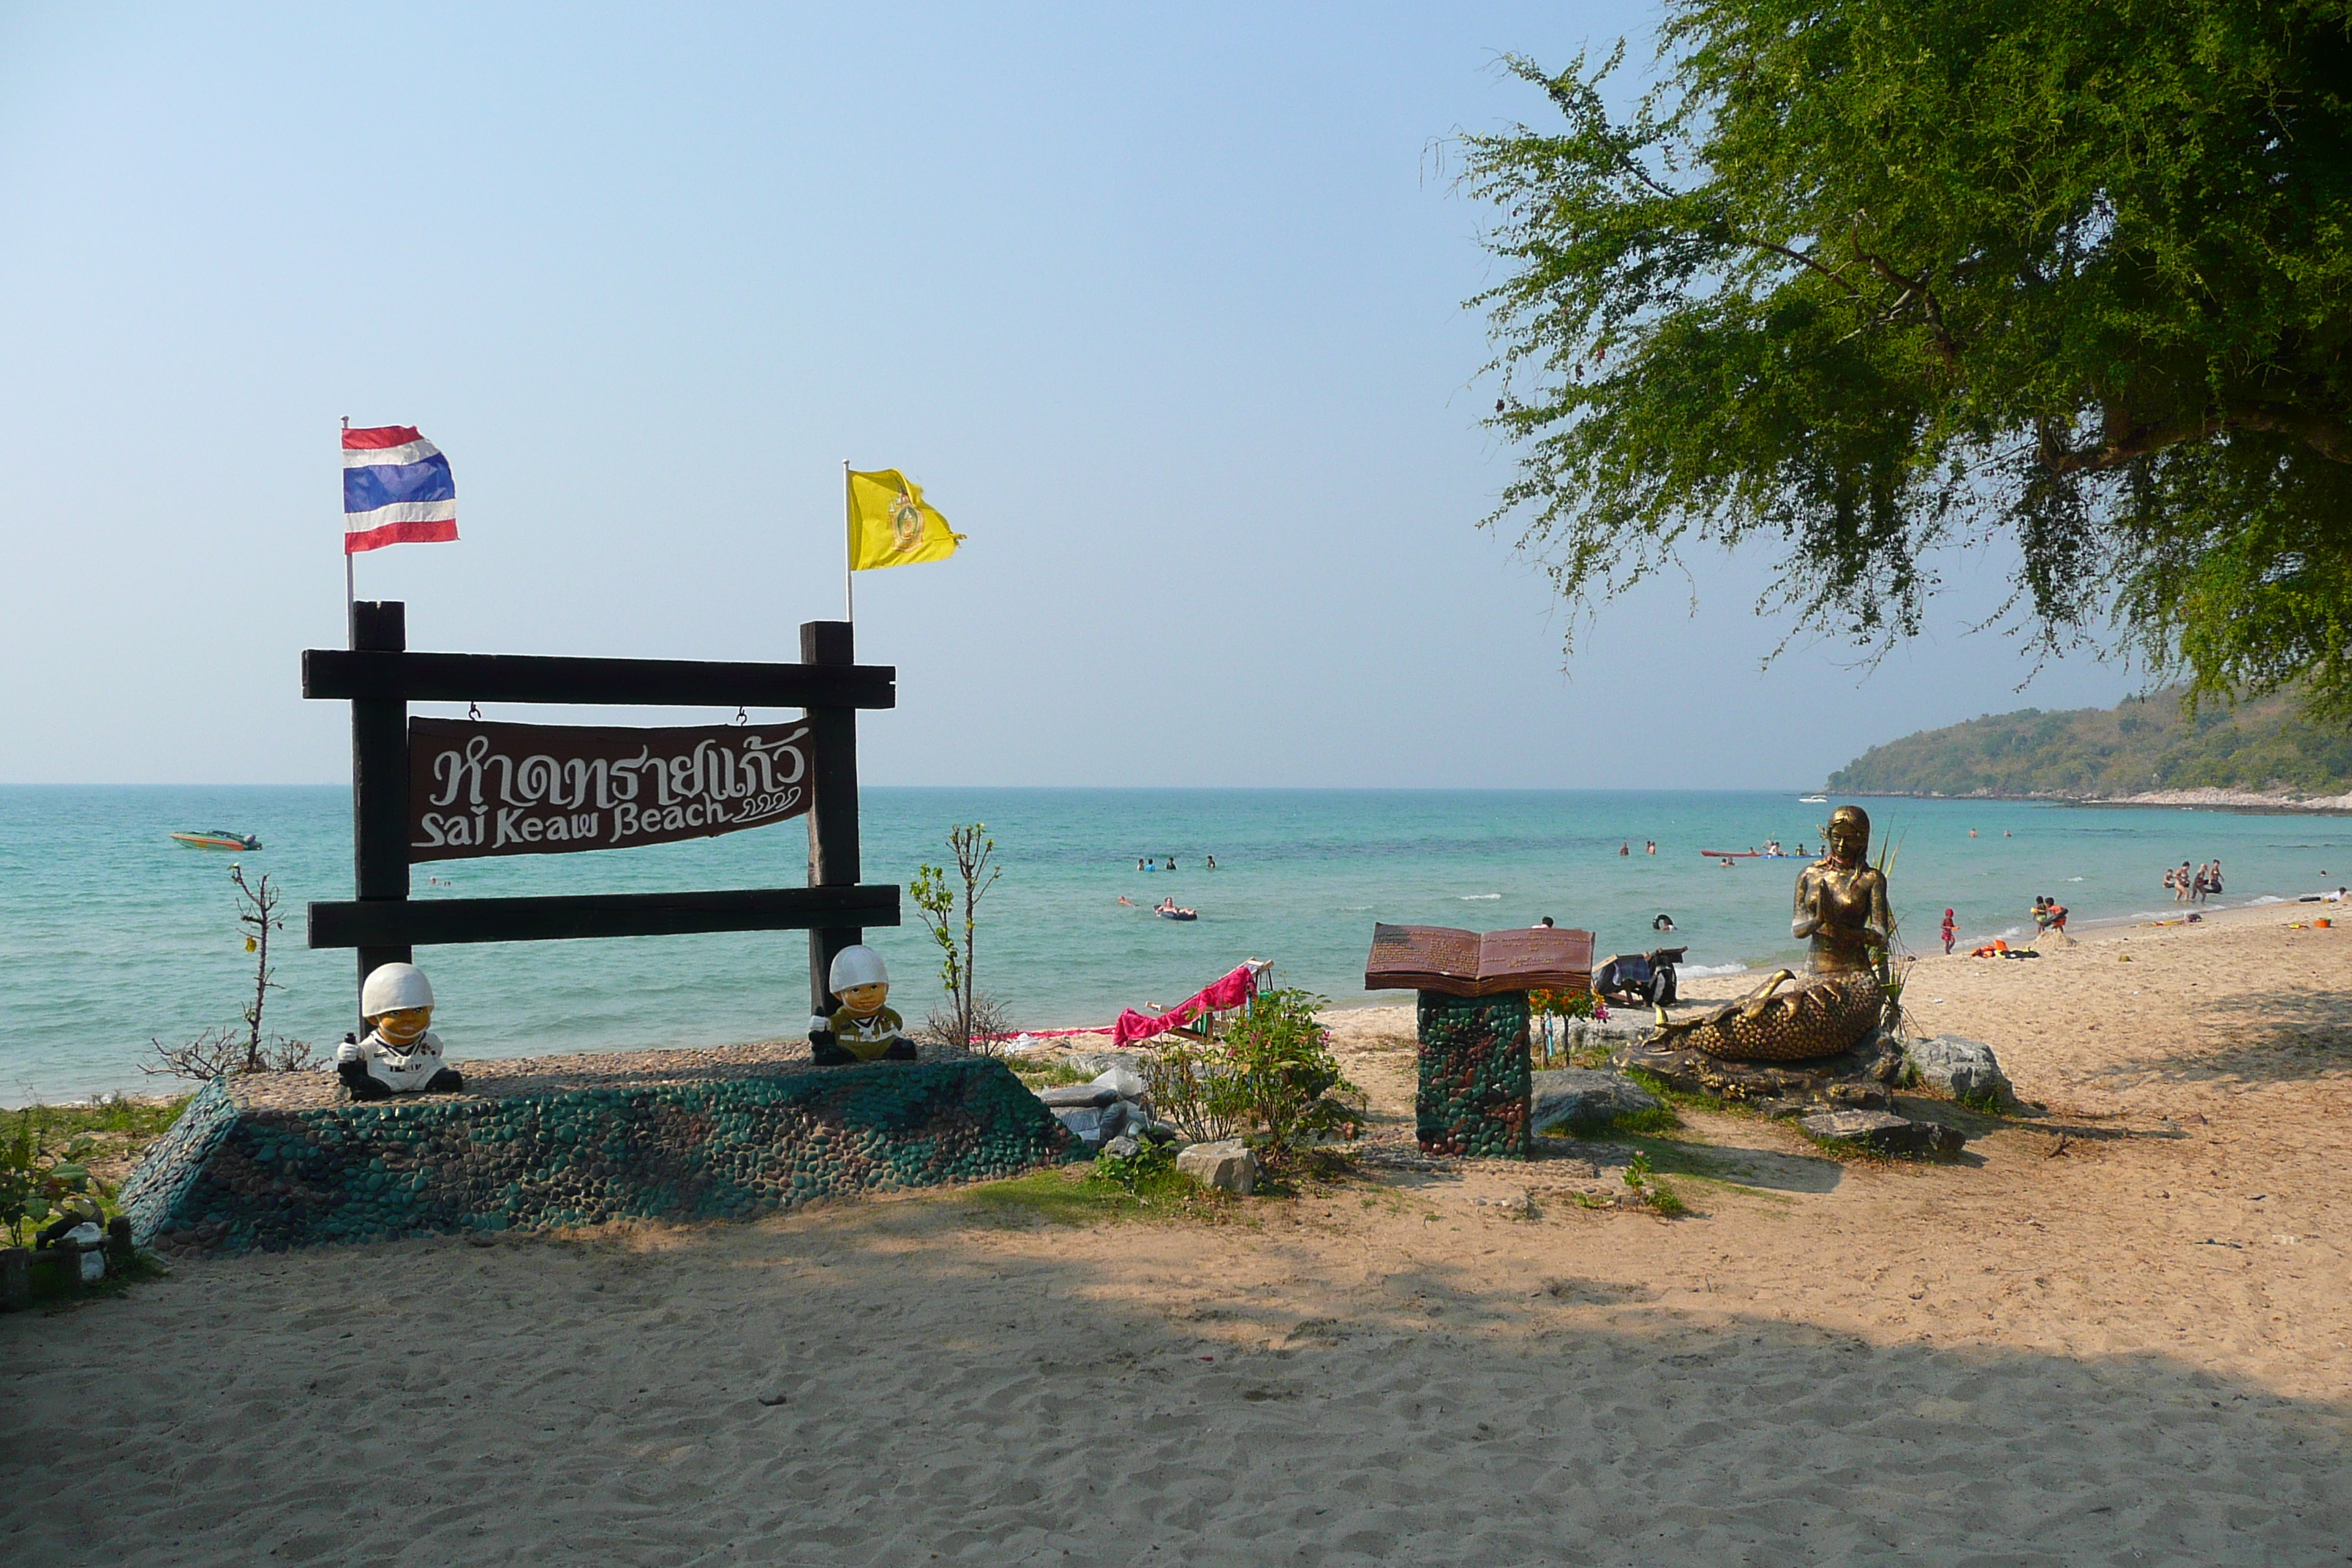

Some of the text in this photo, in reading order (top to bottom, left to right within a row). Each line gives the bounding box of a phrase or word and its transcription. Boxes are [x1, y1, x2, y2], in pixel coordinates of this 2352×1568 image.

[411, 792, 734, 848] Sai Keaw Beach
